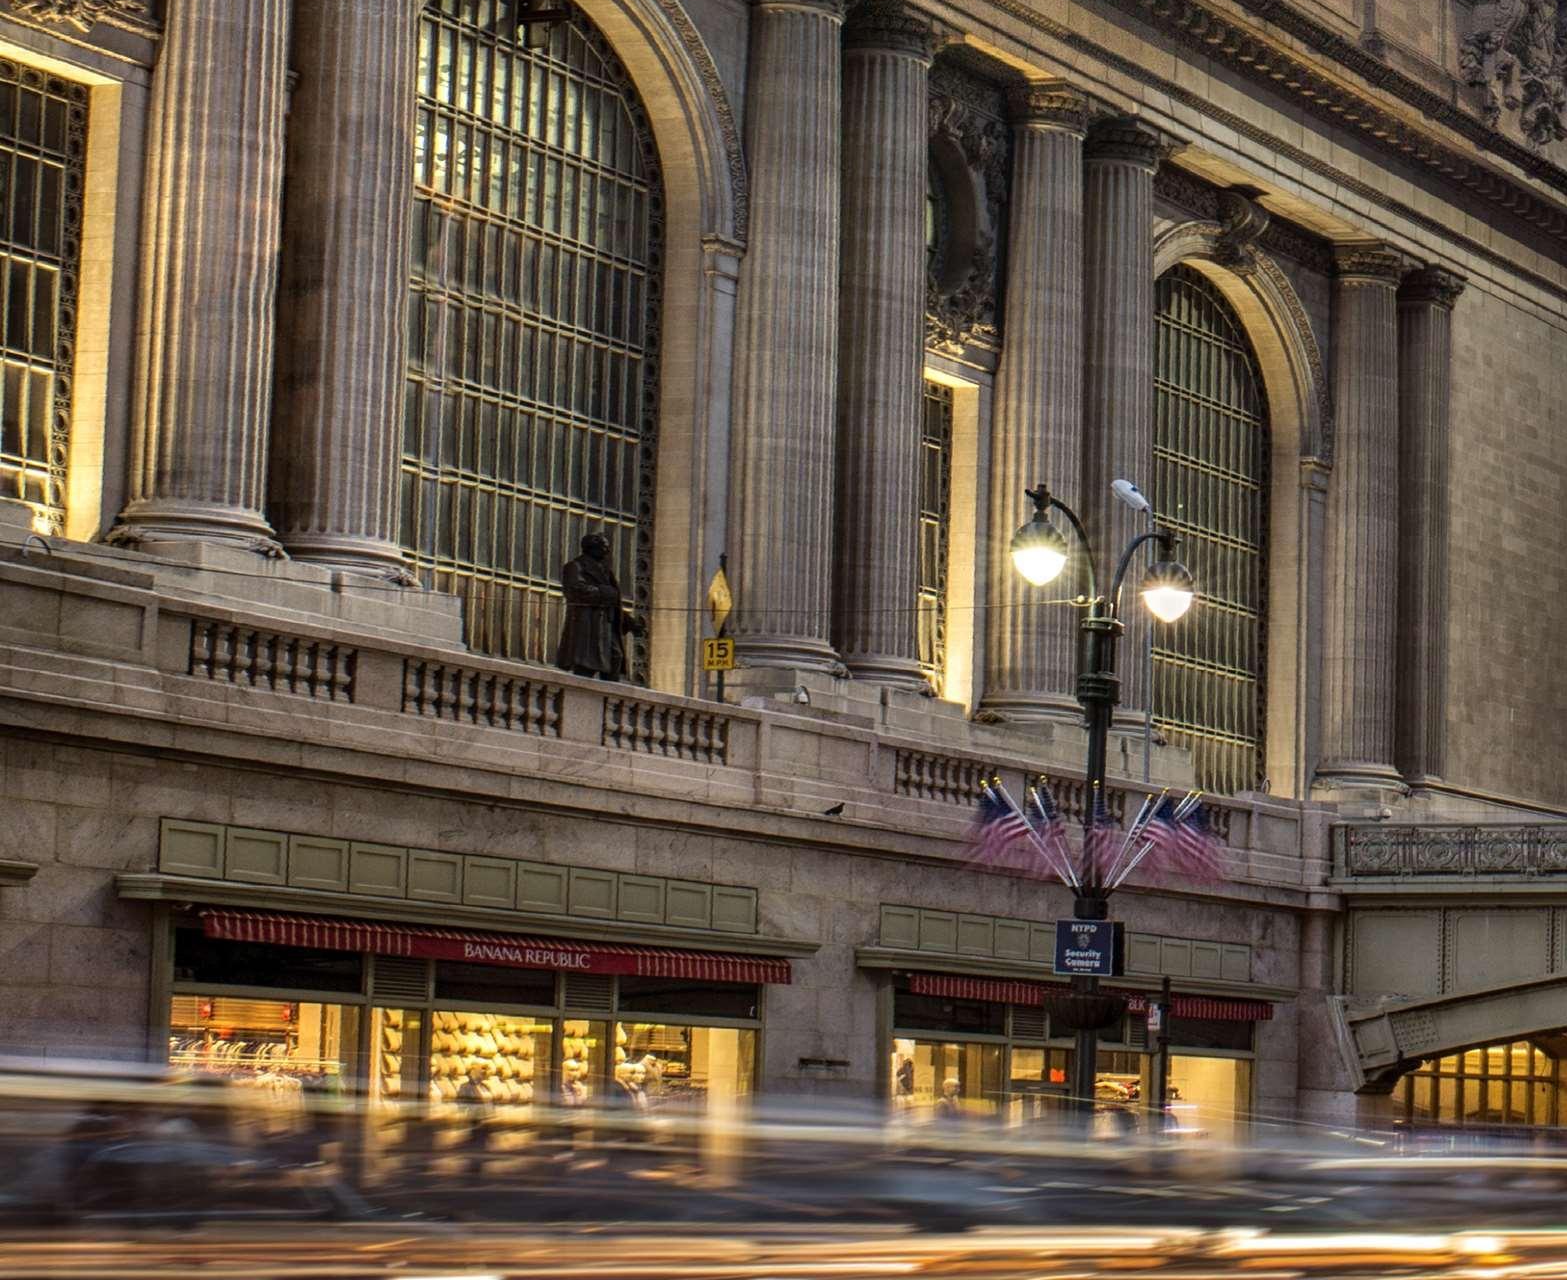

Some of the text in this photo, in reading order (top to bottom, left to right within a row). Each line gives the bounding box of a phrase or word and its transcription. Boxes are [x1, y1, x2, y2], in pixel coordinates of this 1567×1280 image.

[708, 642, 729, 659] 15
[1071, 924, 1098, 933] NYPD
[464, 942, 592, 969] BANANA REPUBLIC
[1065, 948, 1102, 960] Security
[1065, 957, 1101, 967] Camera
